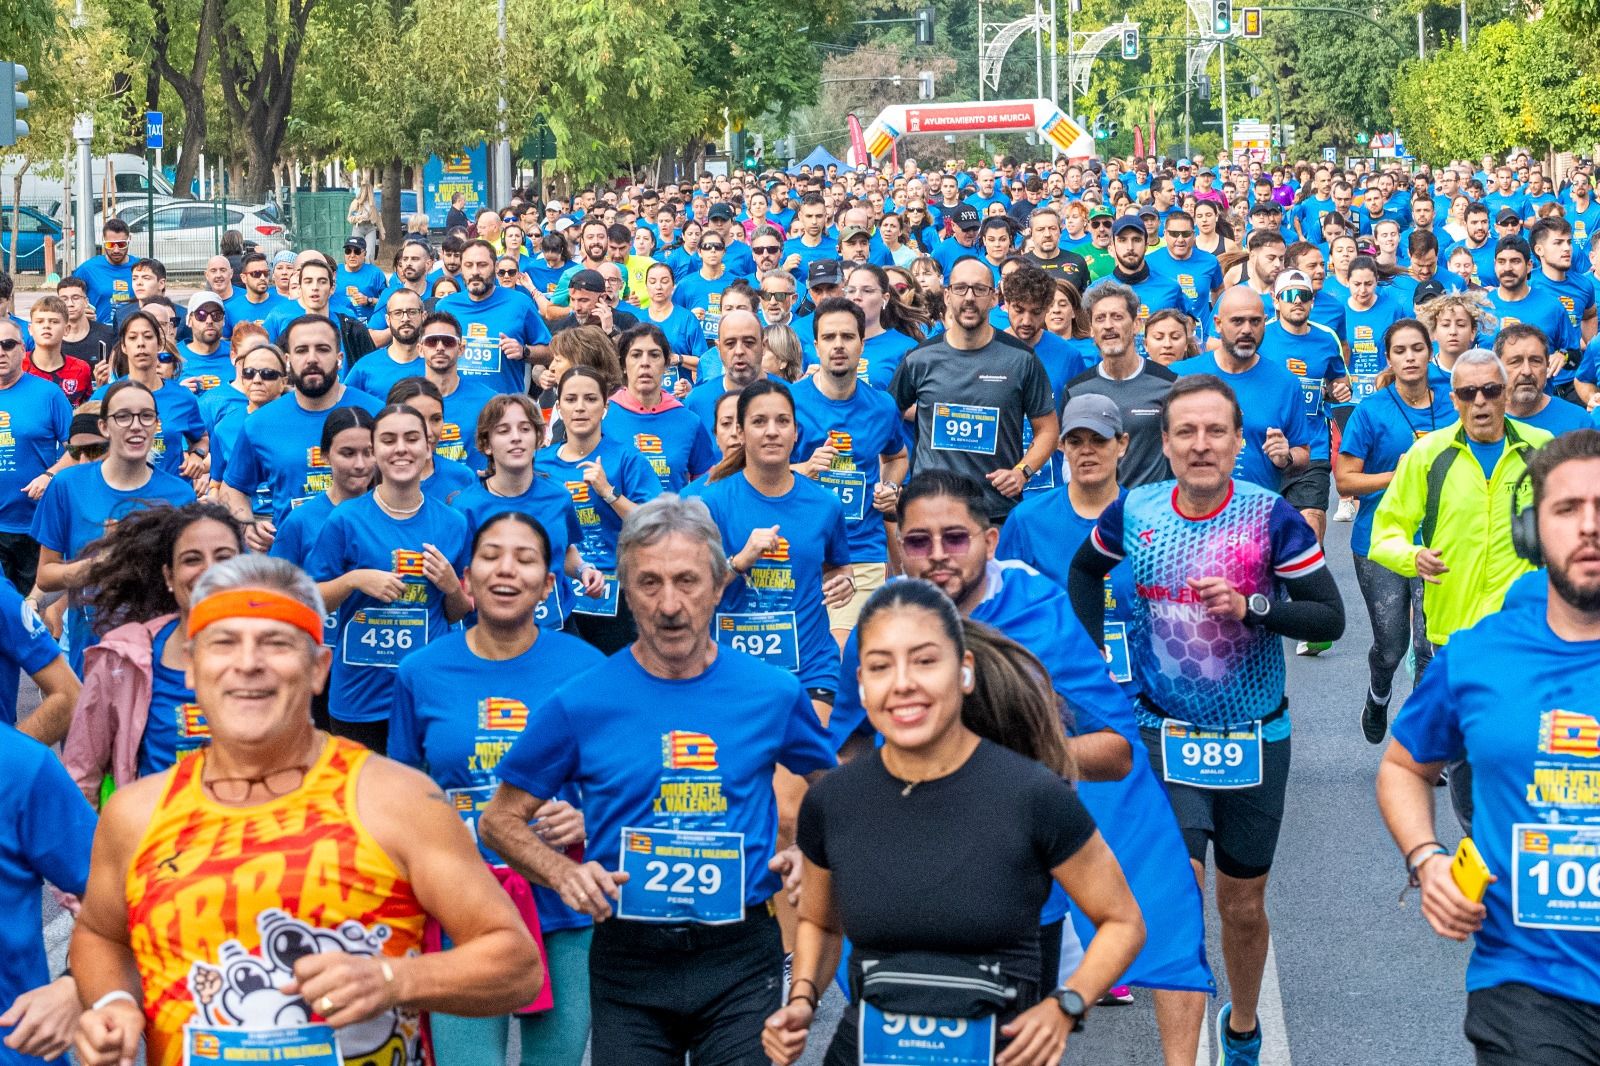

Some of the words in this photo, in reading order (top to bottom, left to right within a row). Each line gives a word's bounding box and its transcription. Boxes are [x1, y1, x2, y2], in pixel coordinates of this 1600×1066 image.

[923, 114, 985, 126] AYUNTAMIENTO
[987, 113, 999, 123] DE
[1000, 112, 1032, 122] MURCIA
[147, 124, 163, 136] TAXI
[945, 419, 983, 438] 991
[571, 579, 611, 600] 21
[360, 627, 413, 649] 436
[731, 633, 782, 656] 692
[1181, 742, 1244, 767] 989
[660, 779, 723, 799] MUÉVETE
[652, 797, 663, 813] X
[665, 796, 729, 813] VALENCIA
[643, 860, 723, 896] 229
[897, 1038, 946, 1050] ESTRELLA
